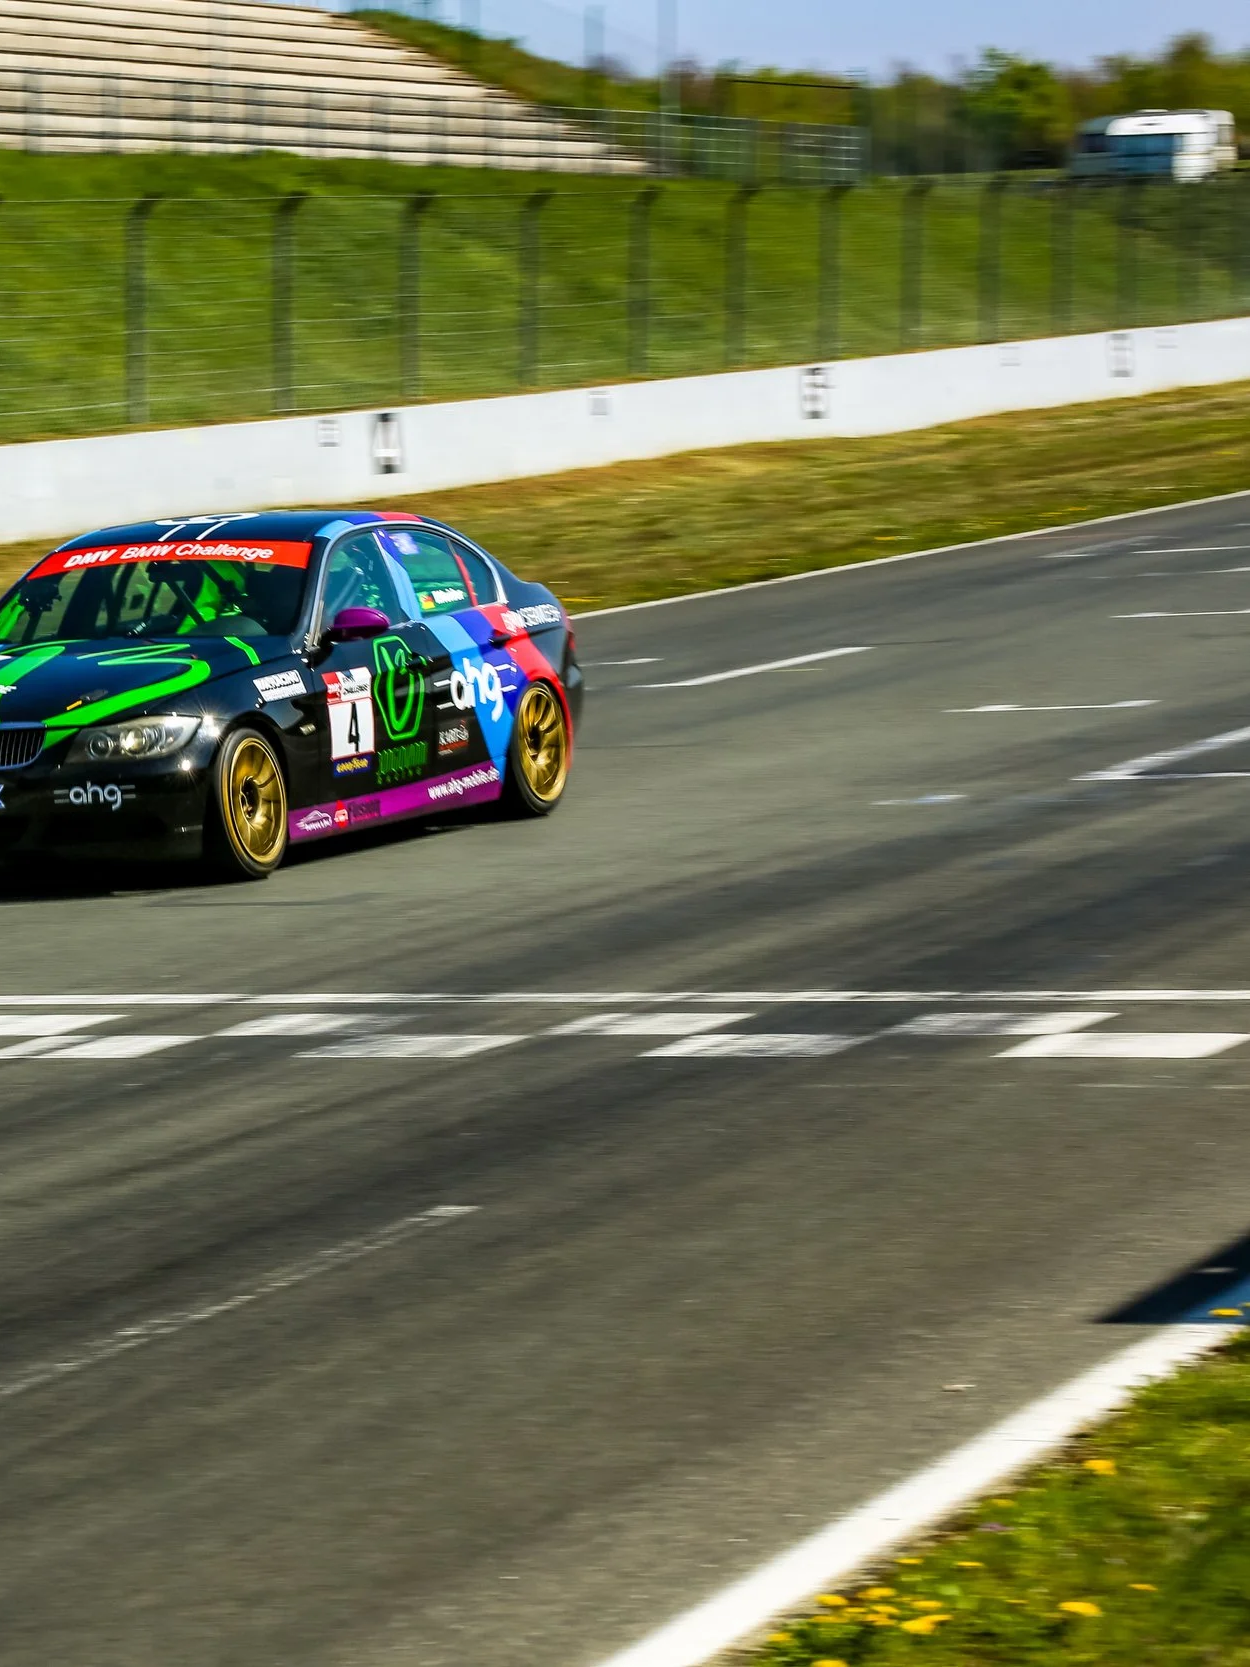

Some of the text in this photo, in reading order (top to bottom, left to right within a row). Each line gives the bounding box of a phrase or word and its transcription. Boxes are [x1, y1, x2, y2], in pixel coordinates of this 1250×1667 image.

[63, 543, 274, 568] DMV BMW Challenge
[451, 657, 504, 722] ahg
[348, 701, 360, 752] 4
[69, 781, 123, 811] ahg
